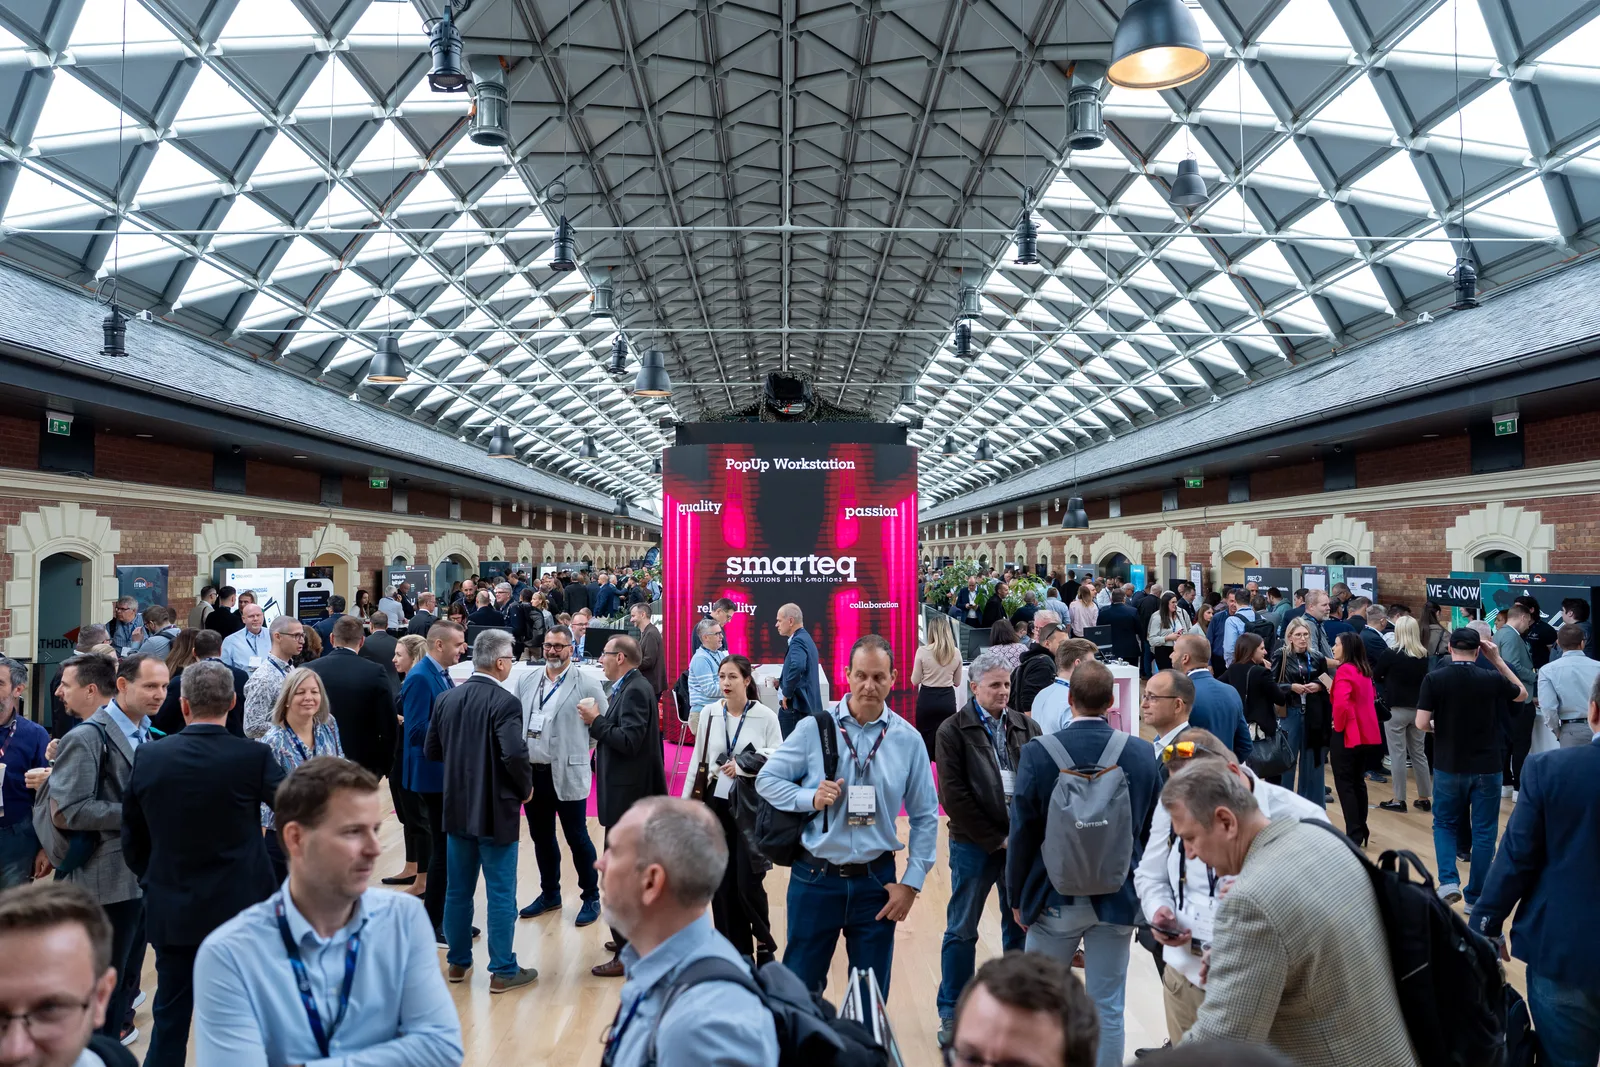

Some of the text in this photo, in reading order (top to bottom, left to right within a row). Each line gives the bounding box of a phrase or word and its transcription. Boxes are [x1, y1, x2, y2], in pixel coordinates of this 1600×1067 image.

[725, 457, 856, 473] PopUp Workstation
[678, 499, 723, 516] quality
[844, 504, 899, 520] passion
[726, 554, 858, 582] smarteq
[785, 575, 802, 583] with
[805, 575, 843, 583] emotions
[697, 601, 757, 616] rellity
[849, 600, 899, 609] collaboration
[38, 638, 75, 649] THORY
